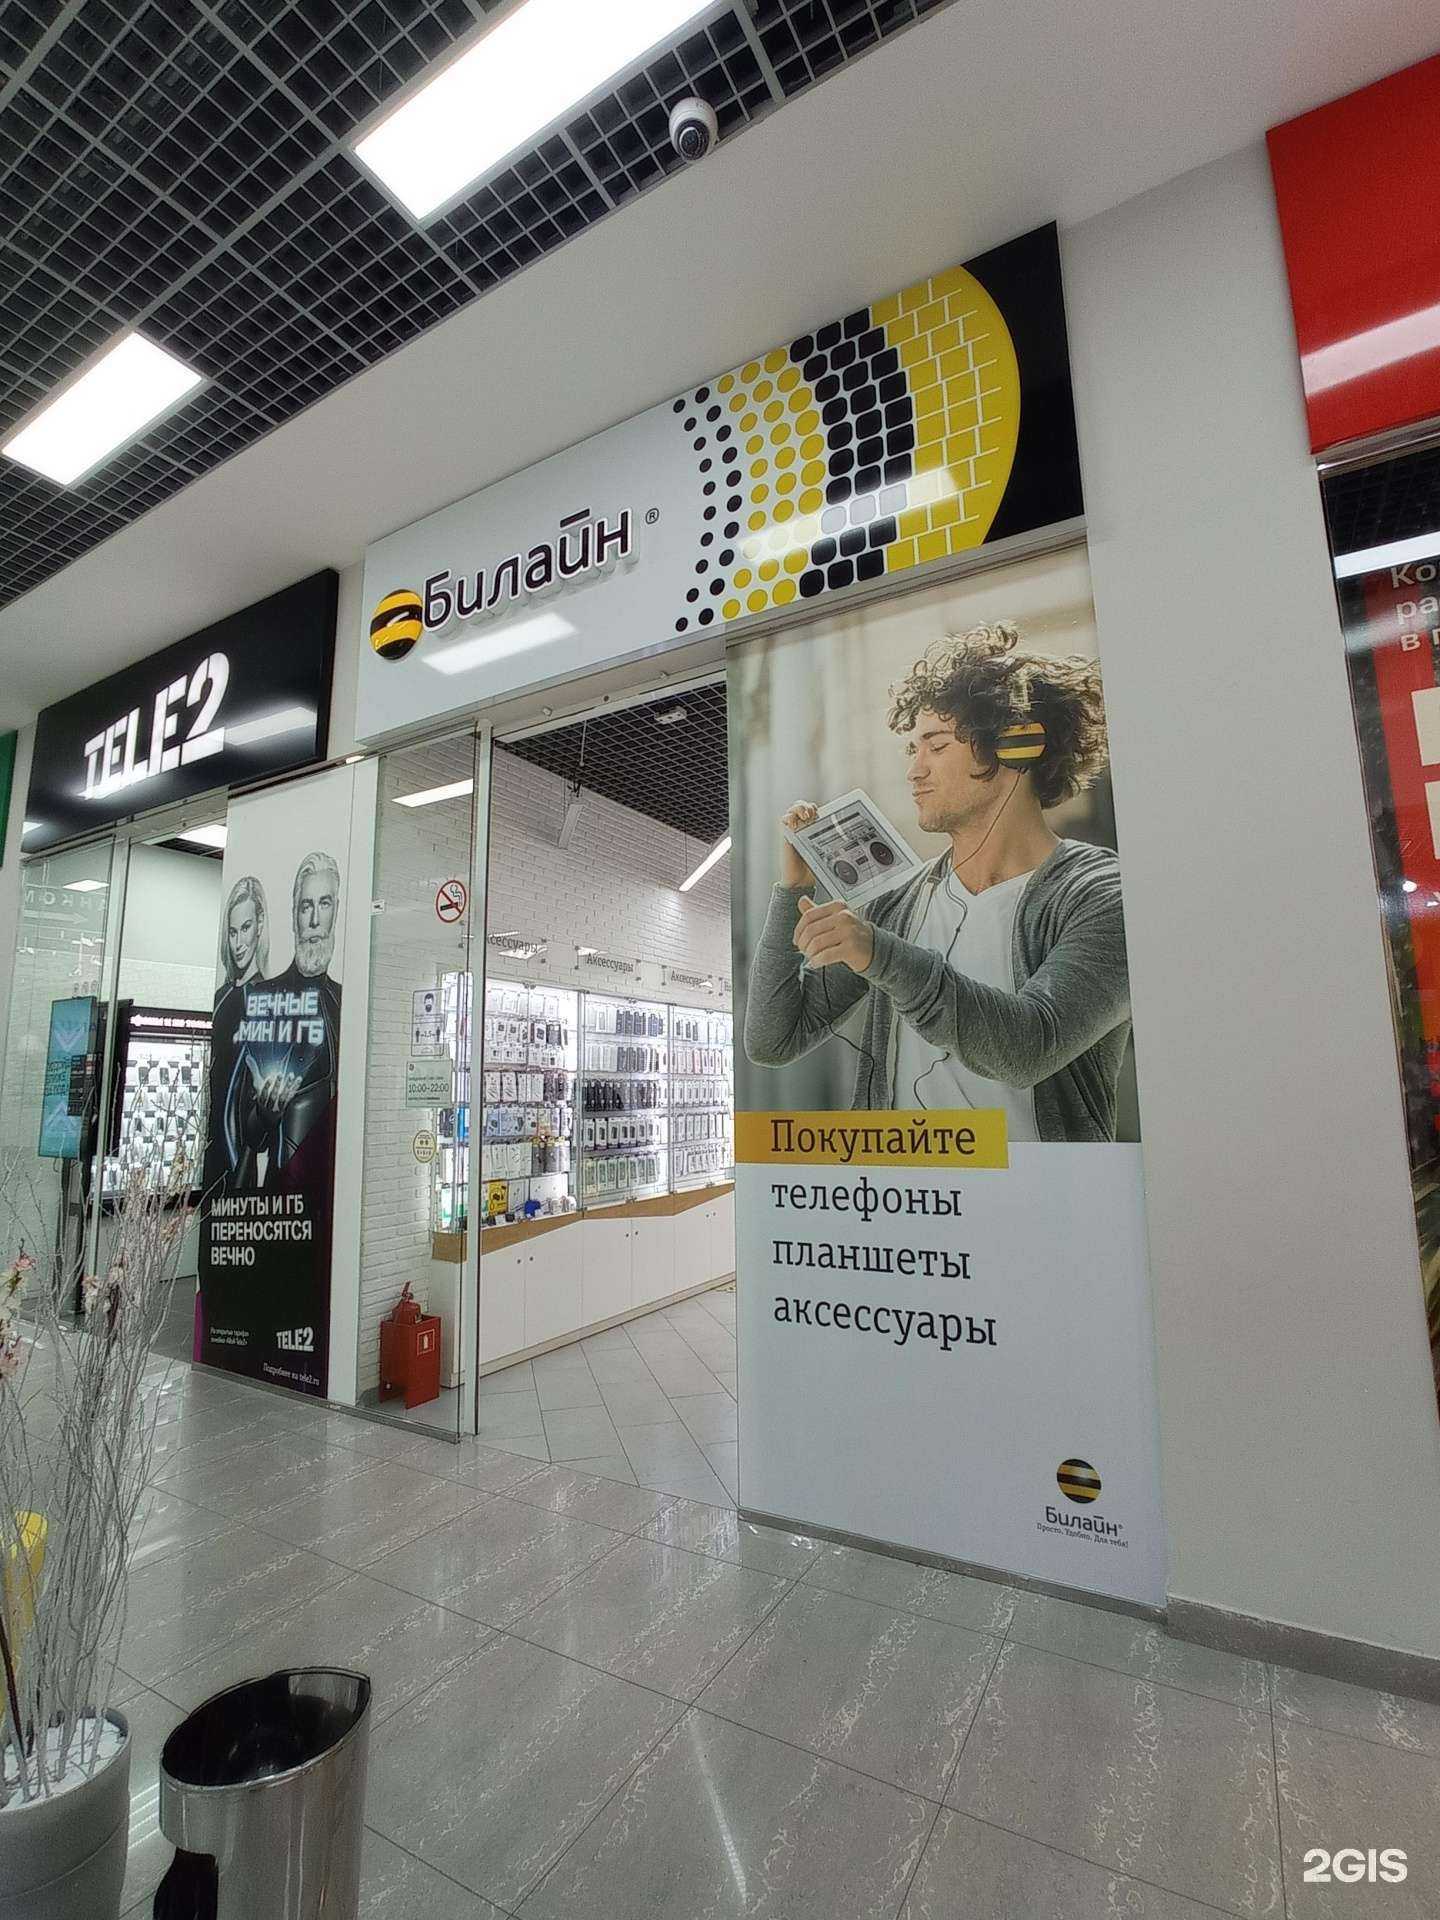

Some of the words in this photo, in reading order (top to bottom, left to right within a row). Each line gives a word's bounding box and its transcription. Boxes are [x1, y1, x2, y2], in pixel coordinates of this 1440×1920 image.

[422, 507, 632, 630] Билайн
[1395, 595, 1440, 625] ра
[83, 652, 230, 800] TELE2
[586, 952, 634, 975] Аксессуары
[246, 990, 319, 1016] ВЕЧНЫЕ
[237, 1019, 275, 1043] МИН
[278, 1019, 293, 1043] И
[296, 1018, 324, 1046] ГБ
[770, 1118, 977, 1162] Покупайте
[210, 1195, 269, 1217] МИНУТЫ
[272, 1195, 282, 1215] И
[286, 1194, 304, 1215] ГБ
[771, 1176, 963, 1222] телефоны
[210, 1219, 312, 1241] ПЕРЕНОСЯТСЯ
[210, 1245, 255, 1266] ВЕЧНО
[772, 1240, 971, 1280] планшеты
[276, 1326, 314, 1352] TELE2
[773, 1296, 998, 1352] аксессуары
[1045, 1506, 1118, 1537] Билайн
